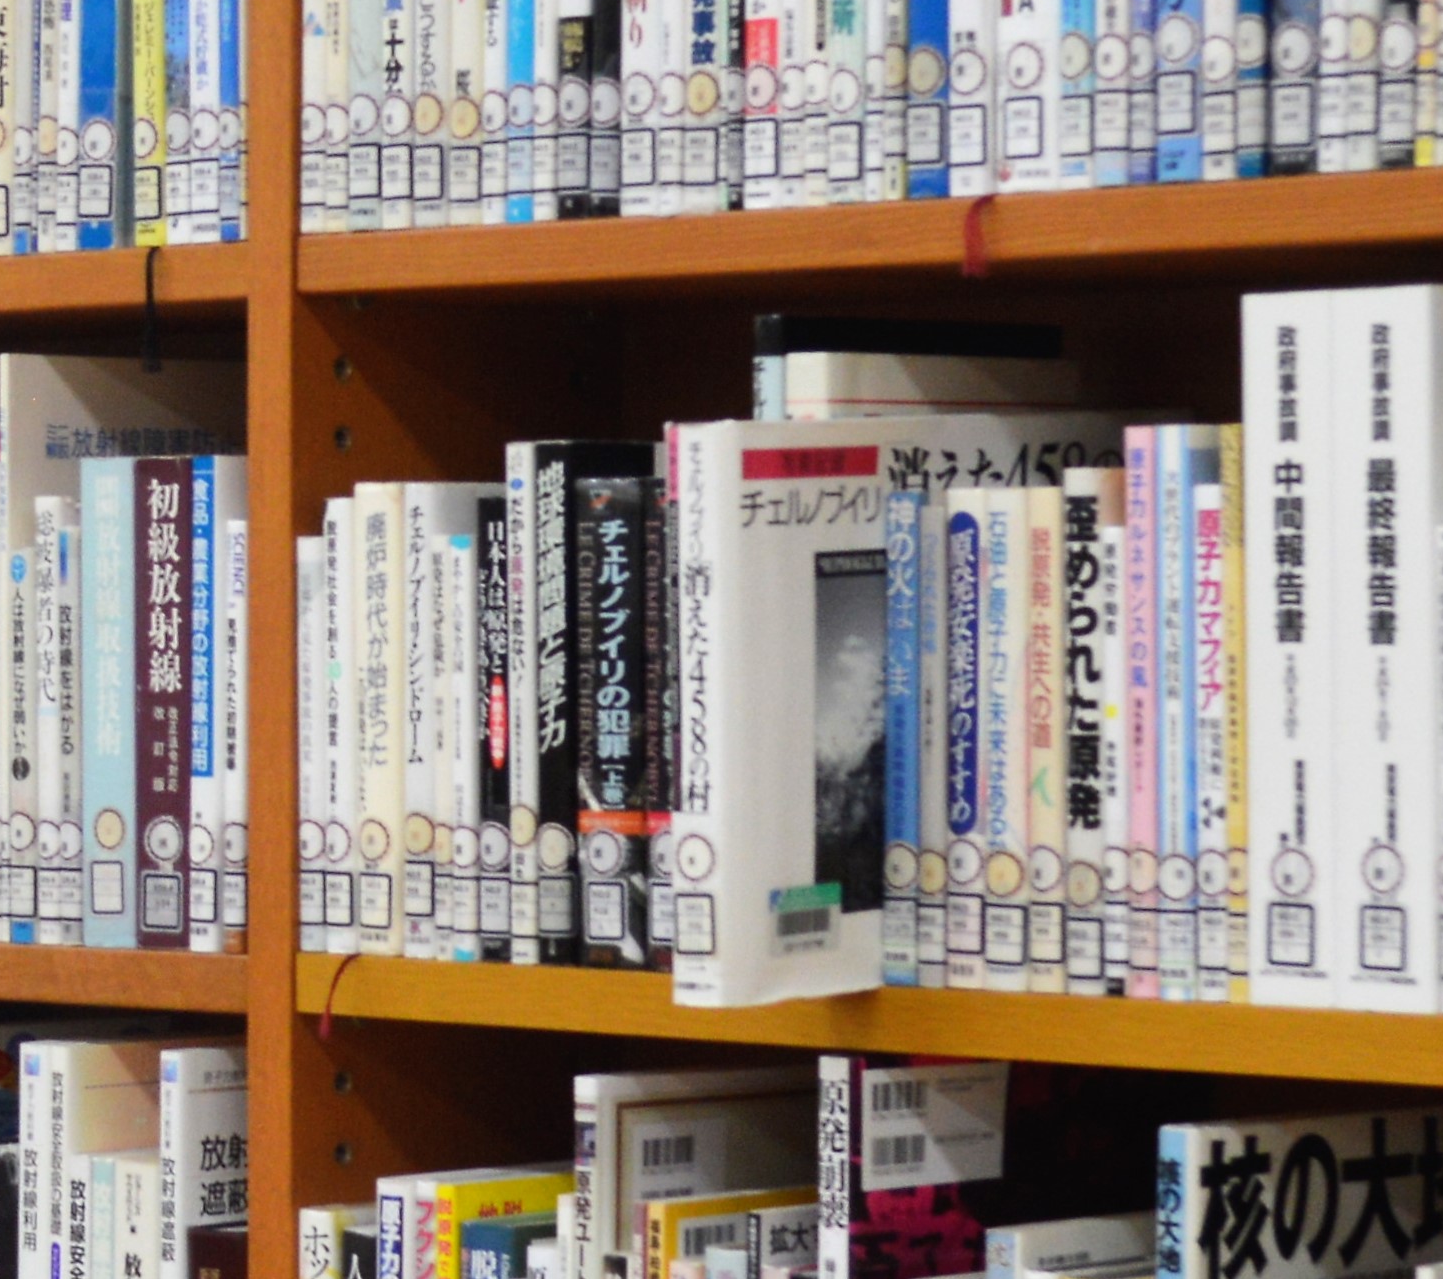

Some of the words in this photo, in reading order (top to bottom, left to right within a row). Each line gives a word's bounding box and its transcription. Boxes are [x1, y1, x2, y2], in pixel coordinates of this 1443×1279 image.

[146, 478, 182, 693] 初級放射線
[741, 487, 882, 529] チェルノブイリ
[1274, 458, 1306, 644] 中間報告書
[598, 520, 630, 758] チェルノブイリの犯罪
[1065, 496, 1101, 830] 歪められた原発
